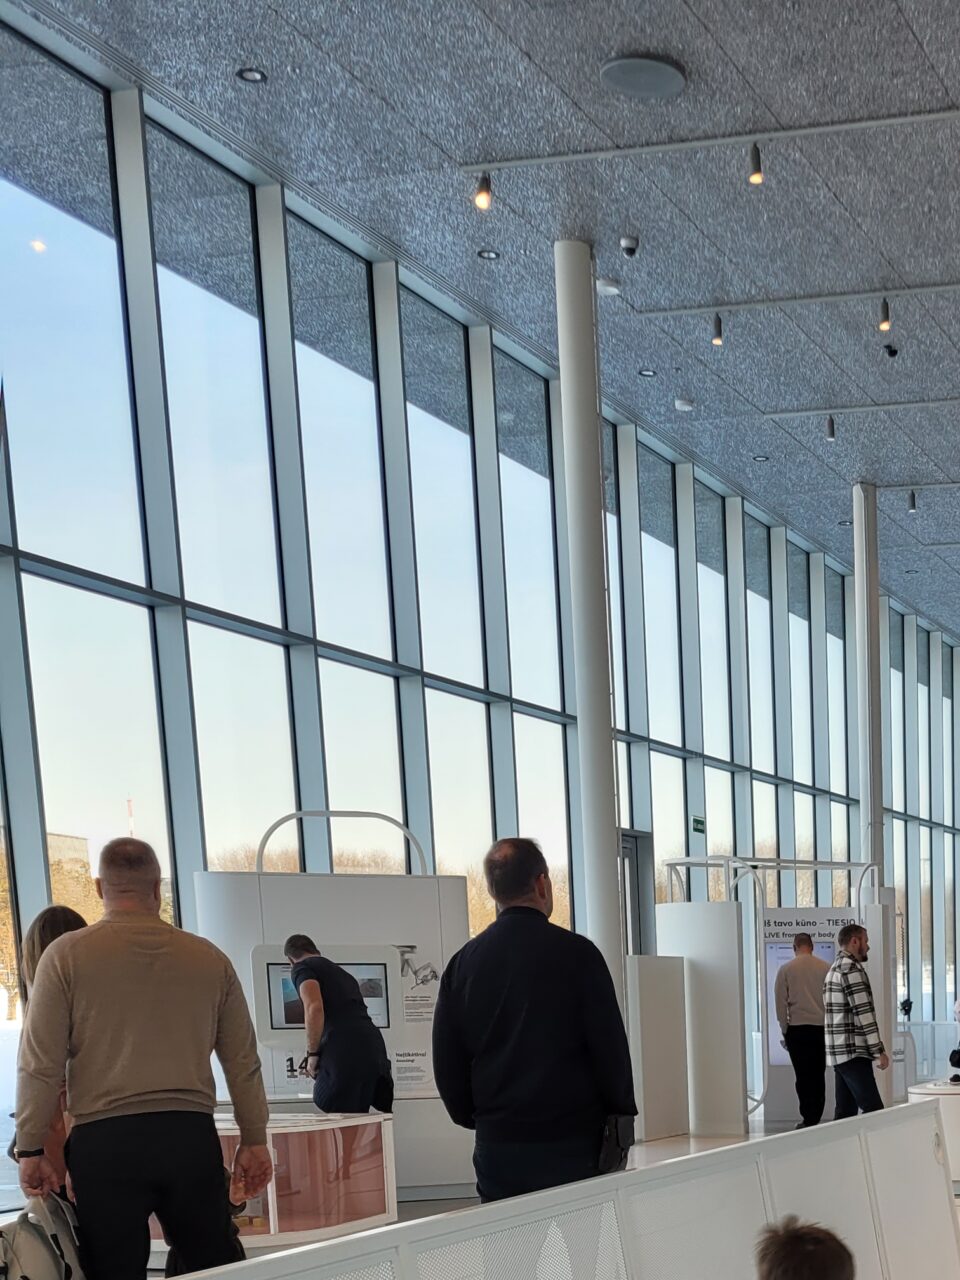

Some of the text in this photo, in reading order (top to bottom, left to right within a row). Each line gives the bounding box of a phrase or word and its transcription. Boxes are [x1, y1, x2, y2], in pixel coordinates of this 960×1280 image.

[774, 919, 793, 927] tavo
[764, 931, 780, 939] LIVE
[818, 931, 836, 939] body
